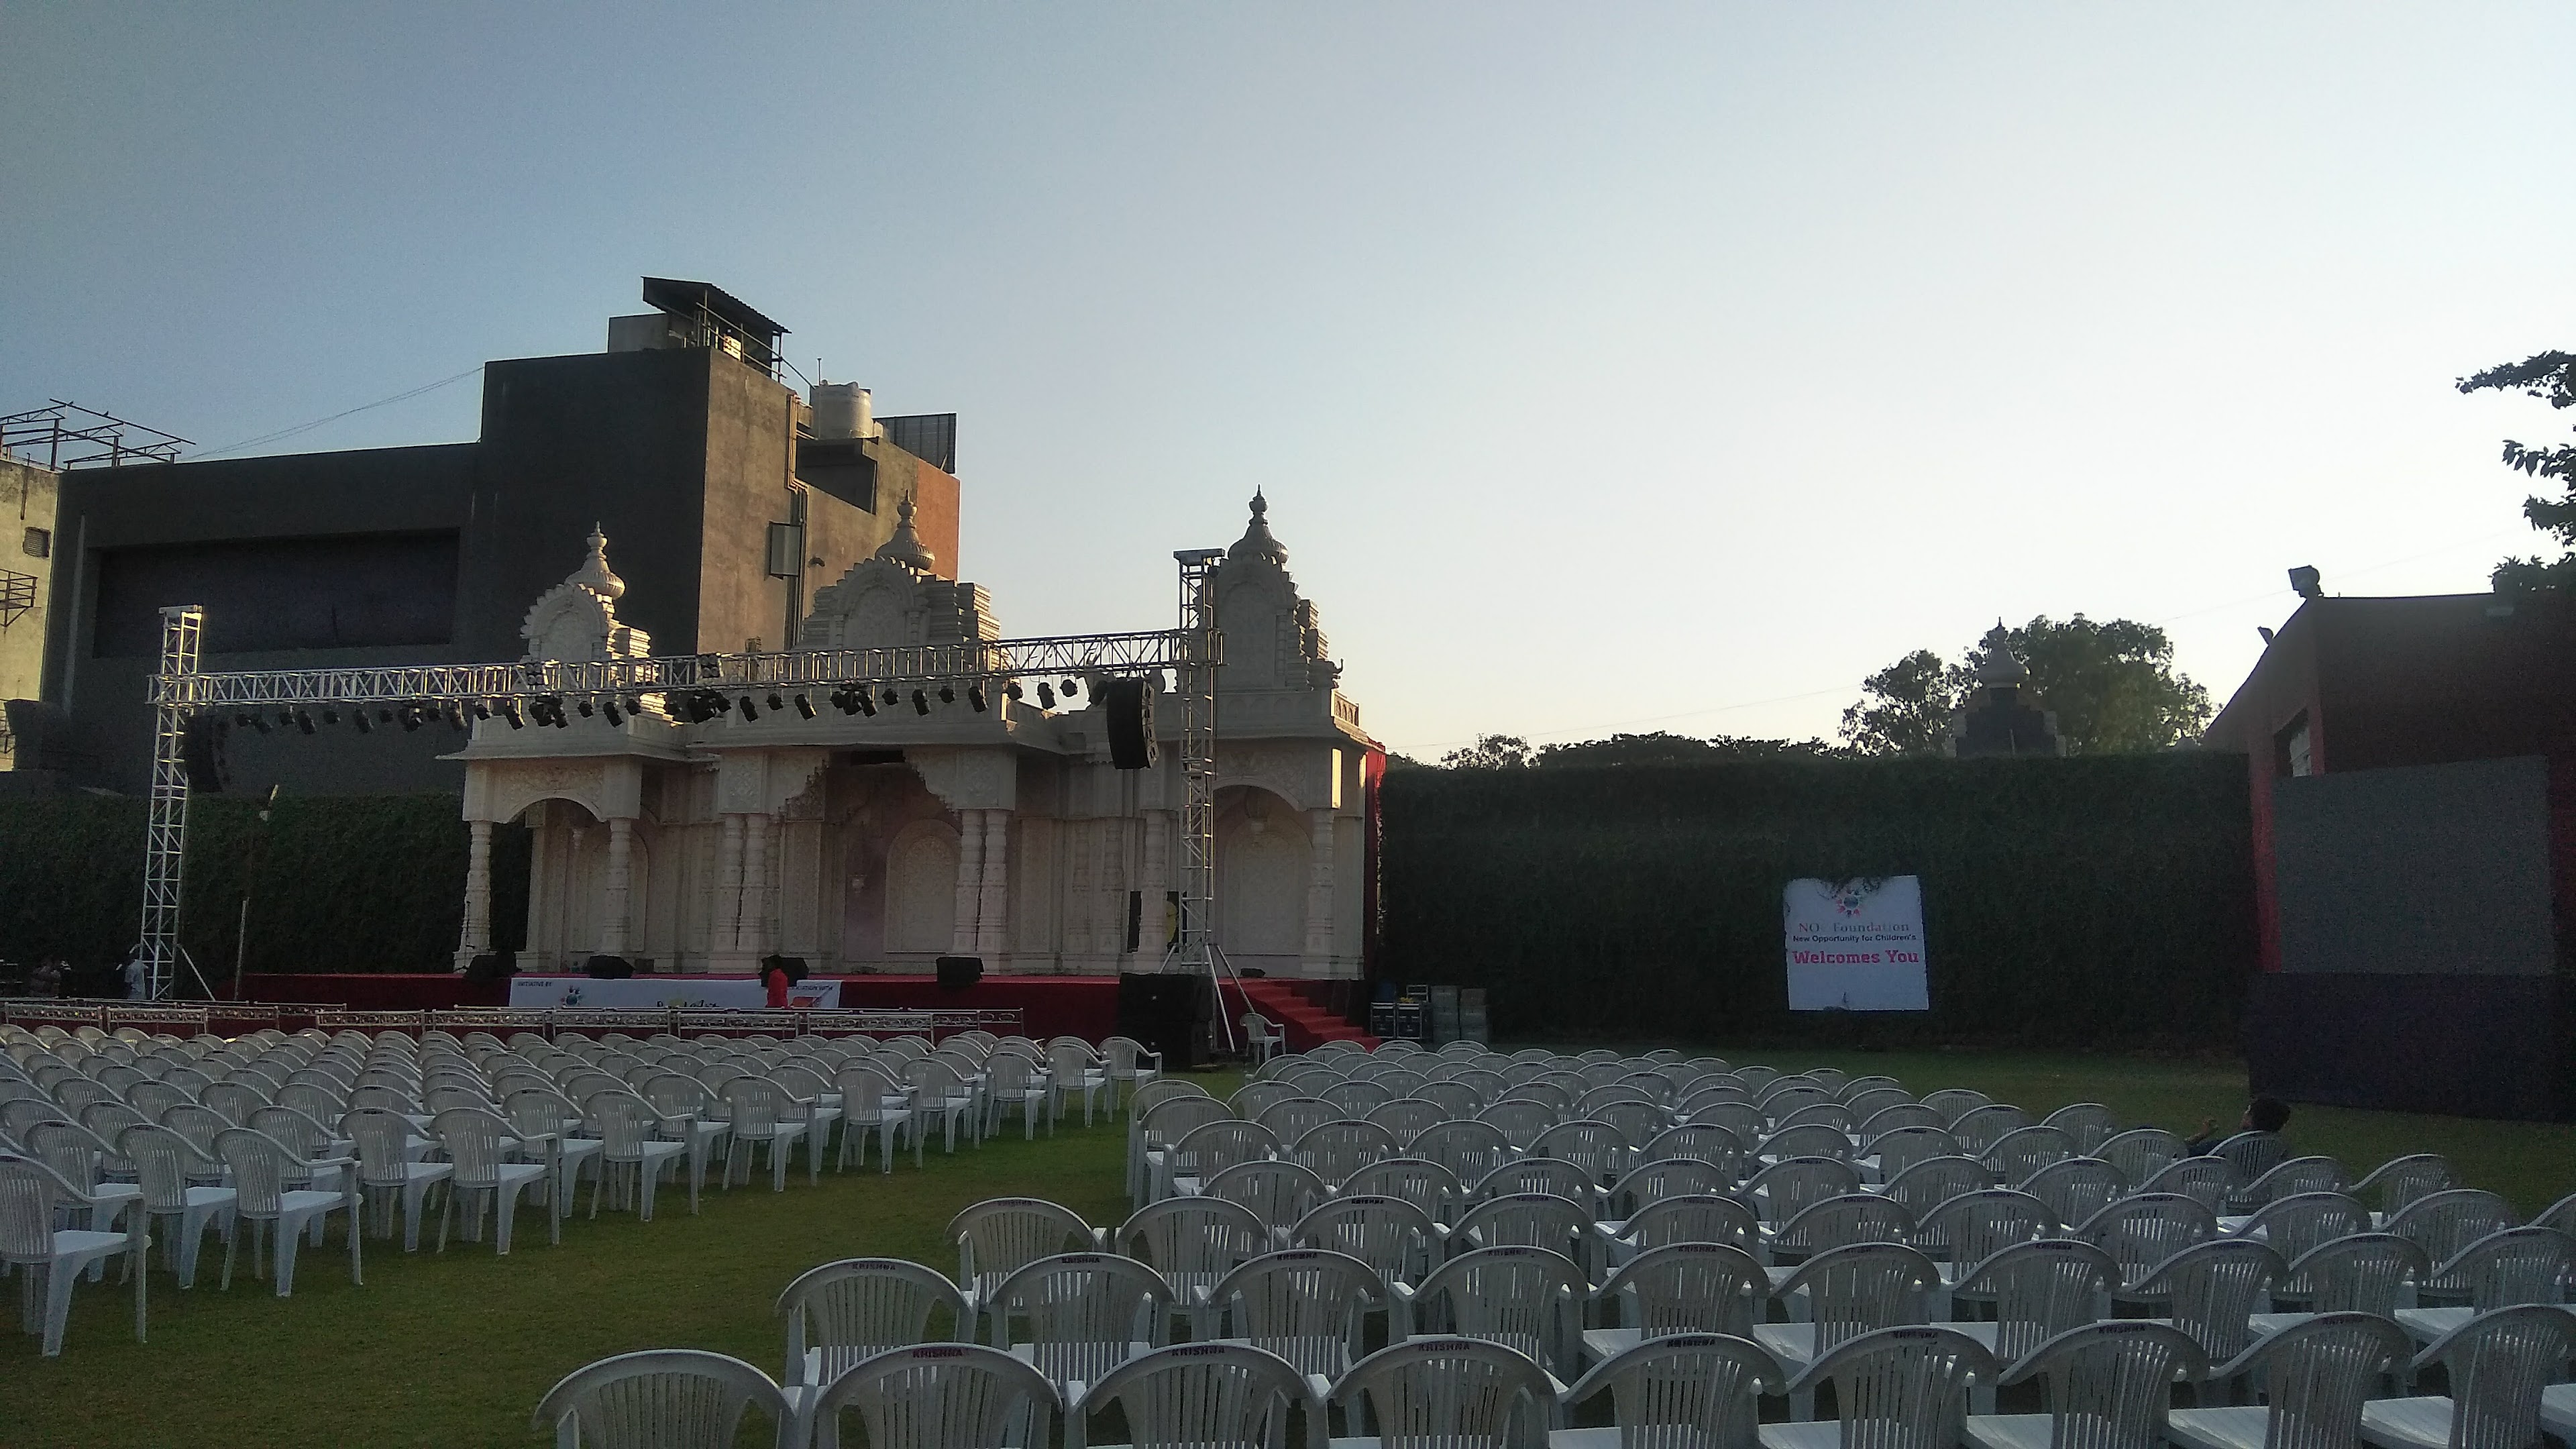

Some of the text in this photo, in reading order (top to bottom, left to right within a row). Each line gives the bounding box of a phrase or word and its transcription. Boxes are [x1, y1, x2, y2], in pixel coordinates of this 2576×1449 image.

[1812, 935, 1859, 943] Opportunity
[1792, 949, 1919, 964] Welcomes You
[1171, 1346, 1225, 1356] KRISHNA
[1418, 1342, 1470, 1352] KRISHNA
[912, 1348, 963, 1358] KRISHNA
